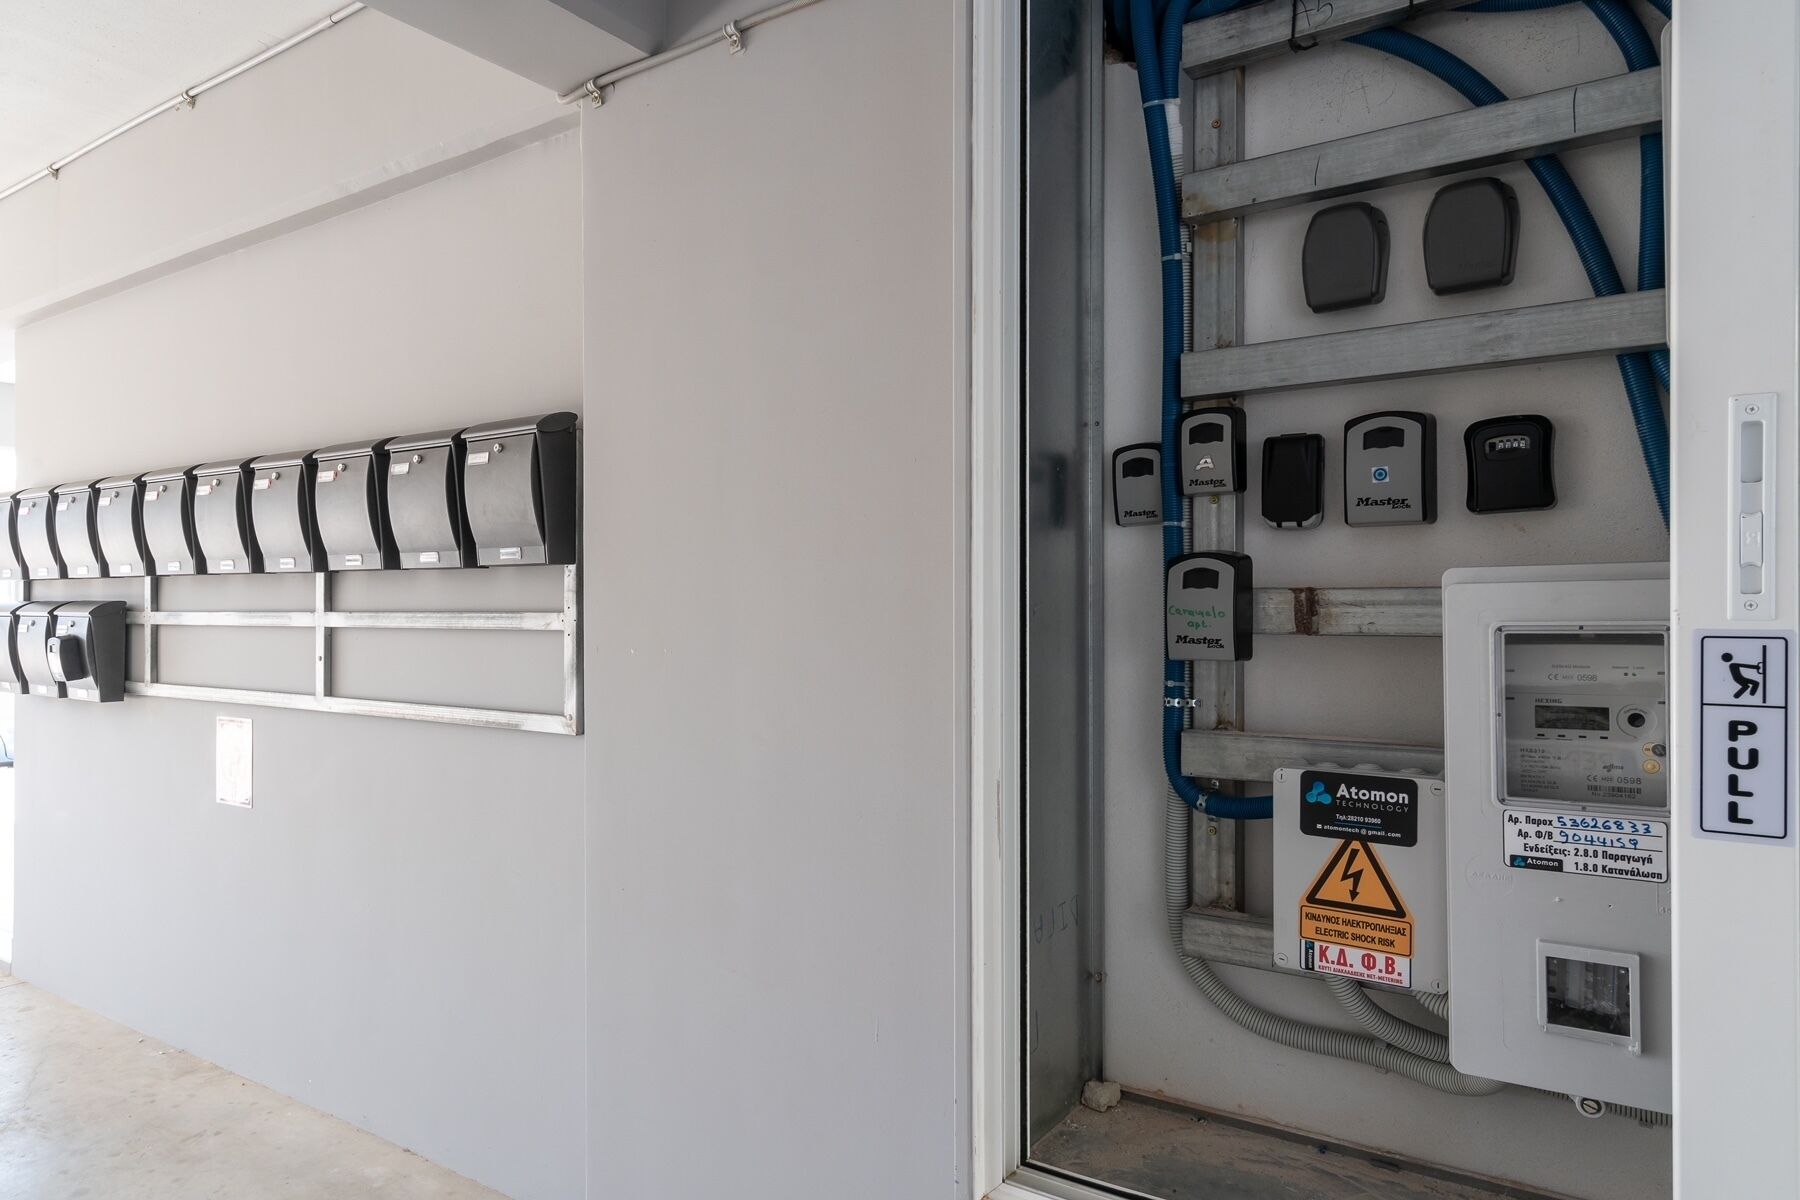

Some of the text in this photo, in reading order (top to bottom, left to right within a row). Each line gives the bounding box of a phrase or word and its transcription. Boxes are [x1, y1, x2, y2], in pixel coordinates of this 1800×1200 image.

[1189, 478, 1225, 487] Master
[1356, 497, 1408, 507] Master
[1123, 509, 1156, 518] Master
[1175, 635, 1222, 644] Master
[1616, 776, 1642, 785] 0598
[1728, 720, 1759, 825] PULL
[1336, 783, 1409, 804] Atomon
[1336, 799, 1409, 813] TECHNOLOGY
[1507, 814, 1652, 834] Αρ. Παροχ 53626833
[1517, 829, 1532, 840] Αρ.
[1523, 843, 1653, 865] Ενδείξεις: 2.8.0 Παραγωγή
[1526, 857, 1559, 867] Atomon
[1574, 861, 1663, 880] 1.8.0 Κατανάλωση
[1305, 911, 1407, 936] ΚΙΝΔΥΝΟΣ ΗΛΕΚΤΡΟΠΛΗΞΙΑΣ
[1315, 927, 1396, 948] ELECTRIC SHOCK RISK
[1318, 944, 1402, 977] Κ.Δ. Φ.Β.
